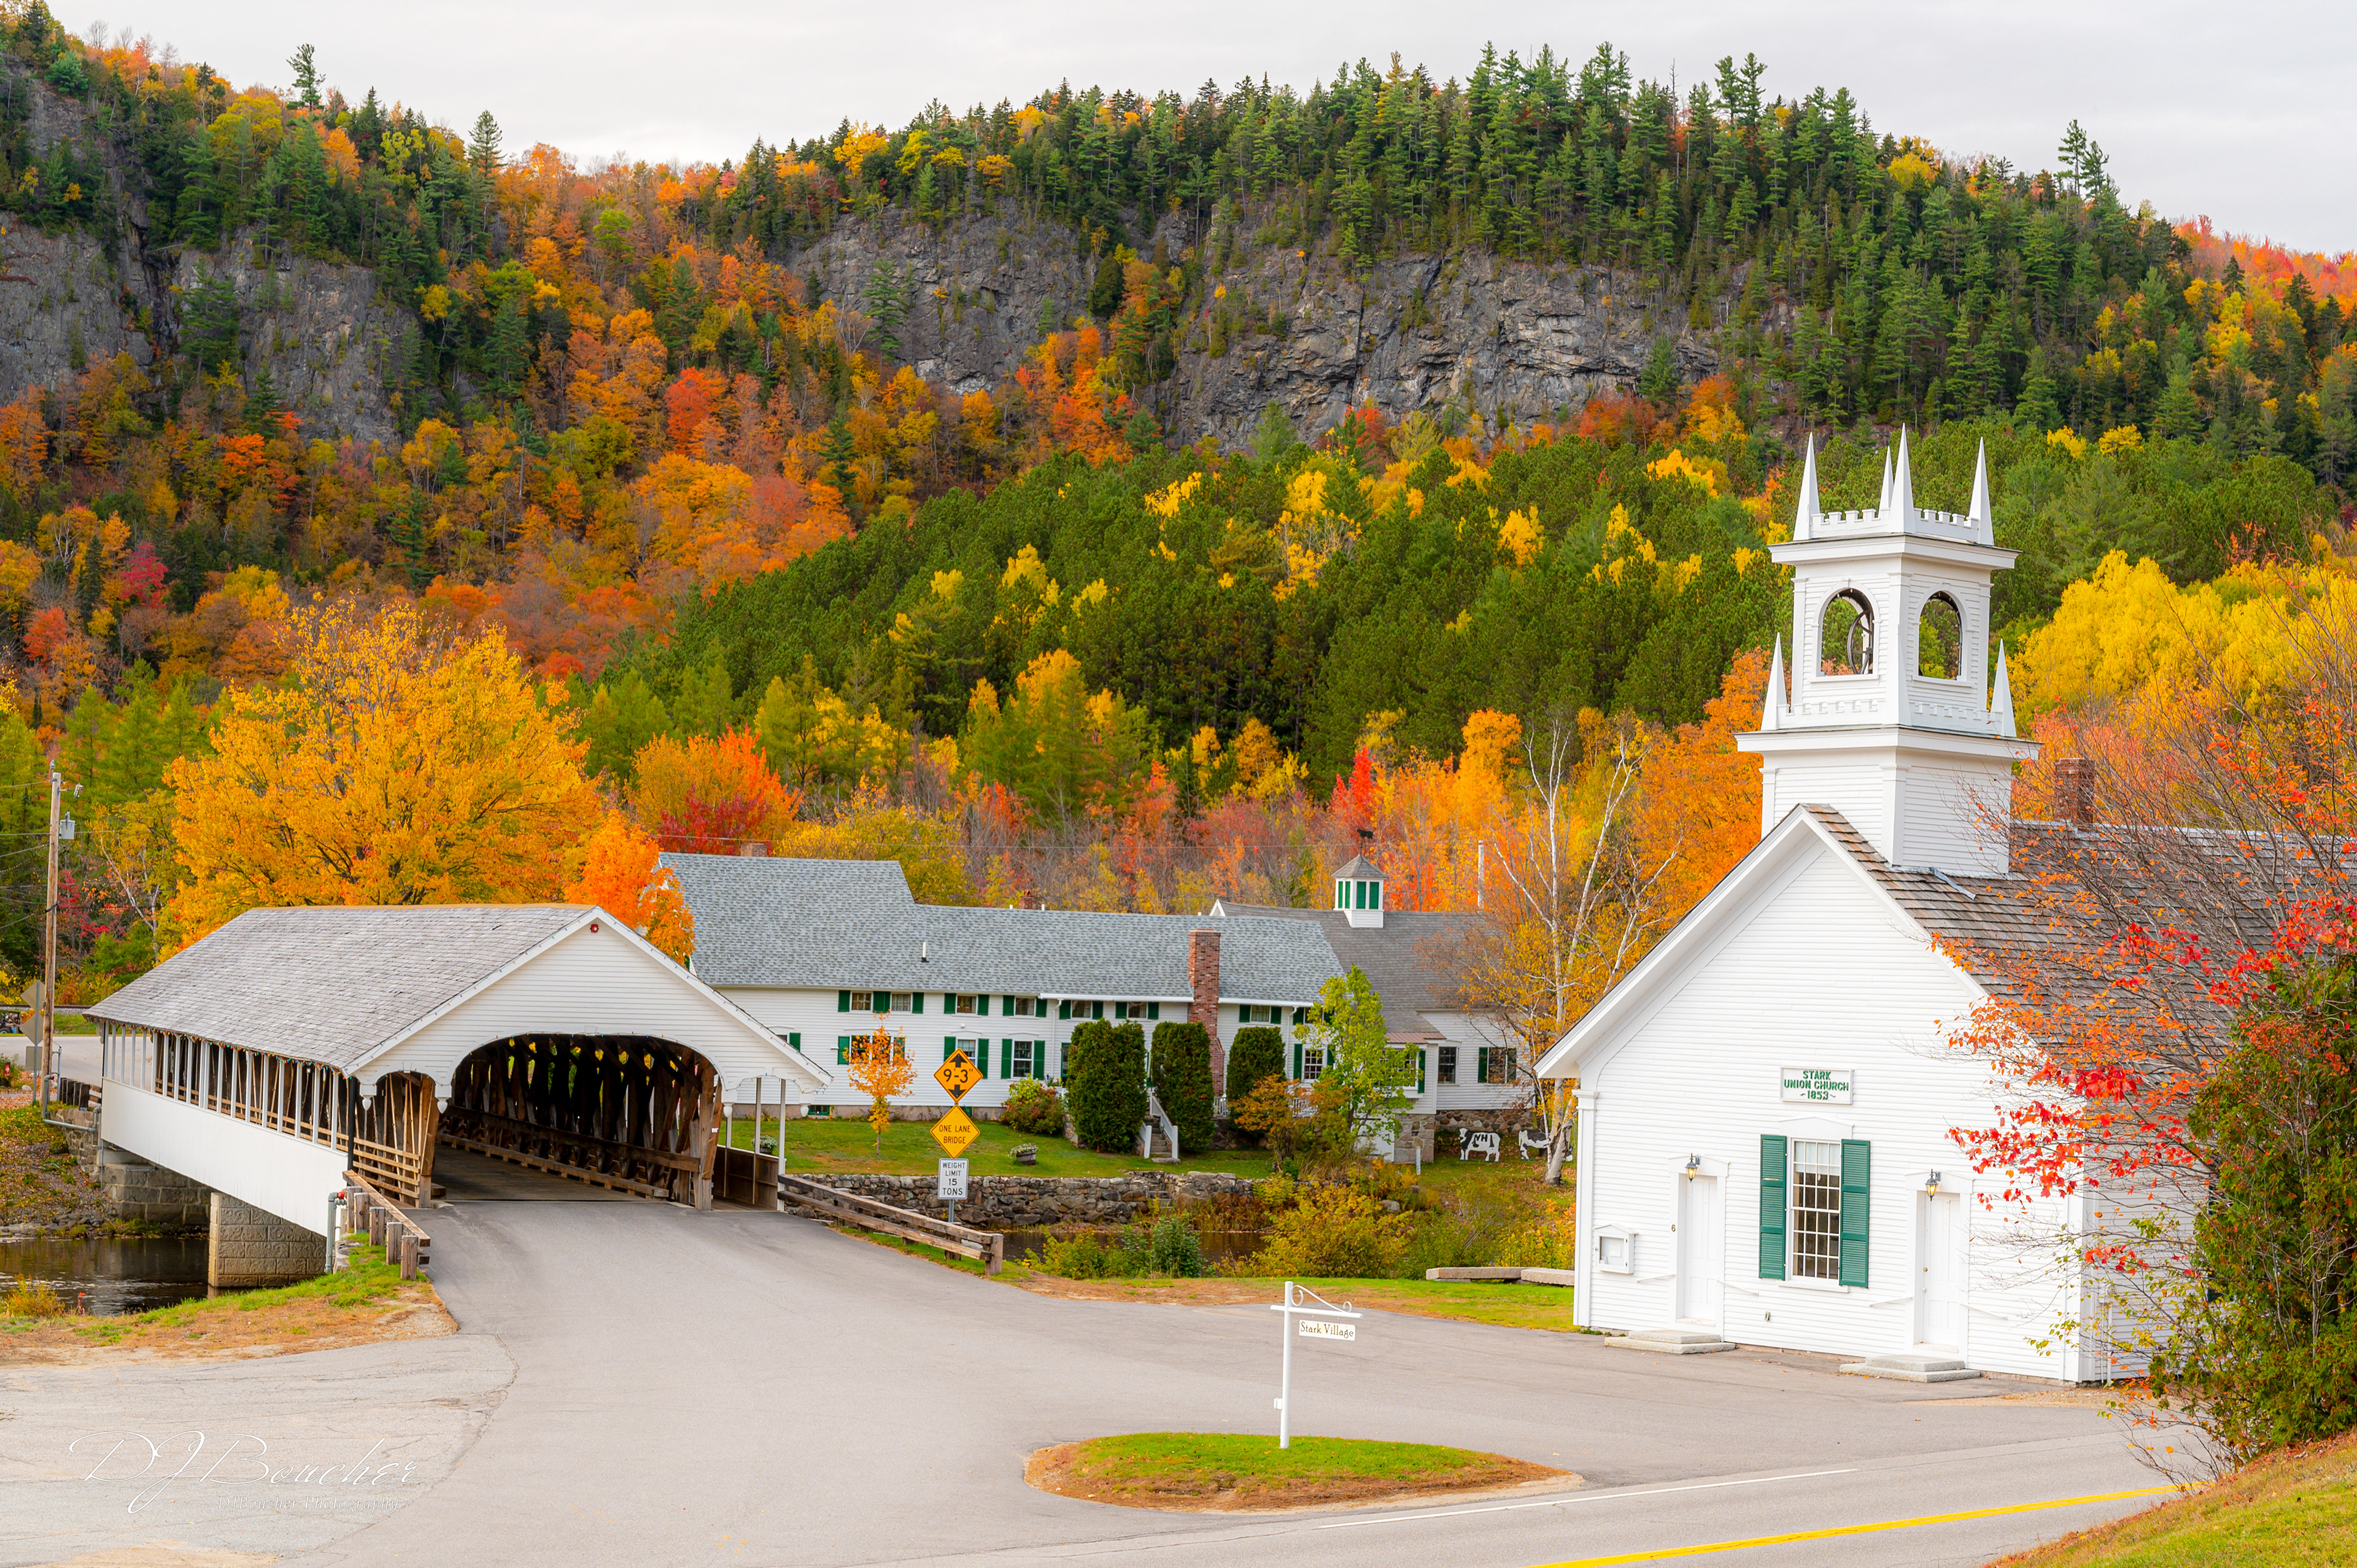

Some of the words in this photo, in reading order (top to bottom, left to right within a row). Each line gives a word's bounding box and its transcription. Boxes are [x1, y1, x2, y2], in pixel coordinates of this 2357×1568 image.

[1803, 1070, 1831, 1080] STARK
[1784, 1079, 1811, 1089] UNION
[1814, 1081, 1849, 1091] CHURCH
[1671, 1224, 1676, 1232] 6
[1300, 1321, 1322, 1334] Stark
[1324, 1324, 1354, 1338] Village
